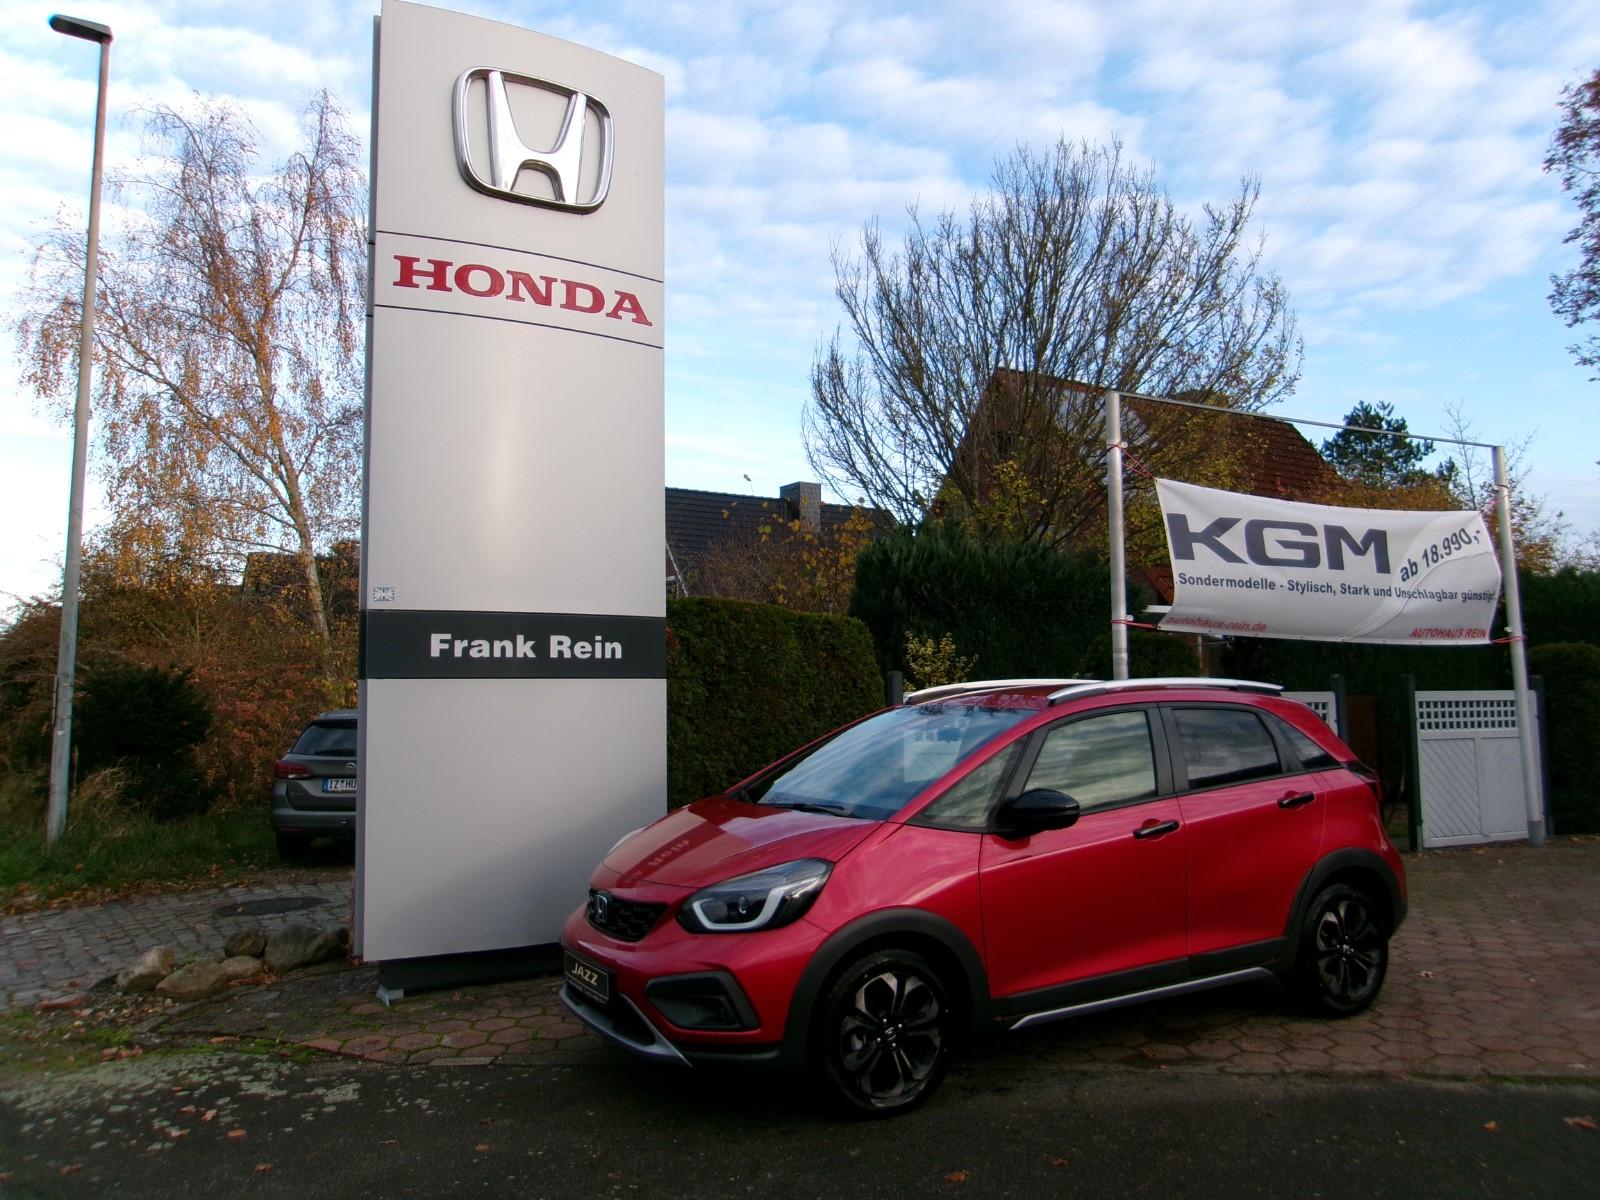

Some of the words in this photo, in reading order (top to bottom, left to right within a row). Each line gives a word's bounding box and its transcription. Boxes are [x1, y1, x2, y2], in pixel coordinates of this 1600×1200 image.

[392, 254, 653, 327] HONDA
[1166, 512, 1391, 575] KGM
[1400, 558, 1418, 582] ab
[1178, 572, 1276, 591] Sondermodelle
[1287, 579, 1337, 596] Stylisch,
[1340, 582, 1370, 596] Stark
[1373, 585, 1392, 597] und
[1395, 586, 1458, 602] Unschlagbar
[1166, 616, 1267, 632] autohaus-rein.de
[1409, 627, 1463, 639] AUTOHAUS
[1464, 627, 1488, 639] REIN
[430, 633, 536, 659] Frank
[549, 634, 622, 659] Rein
[571, 962, 599, 986] JAZZ
